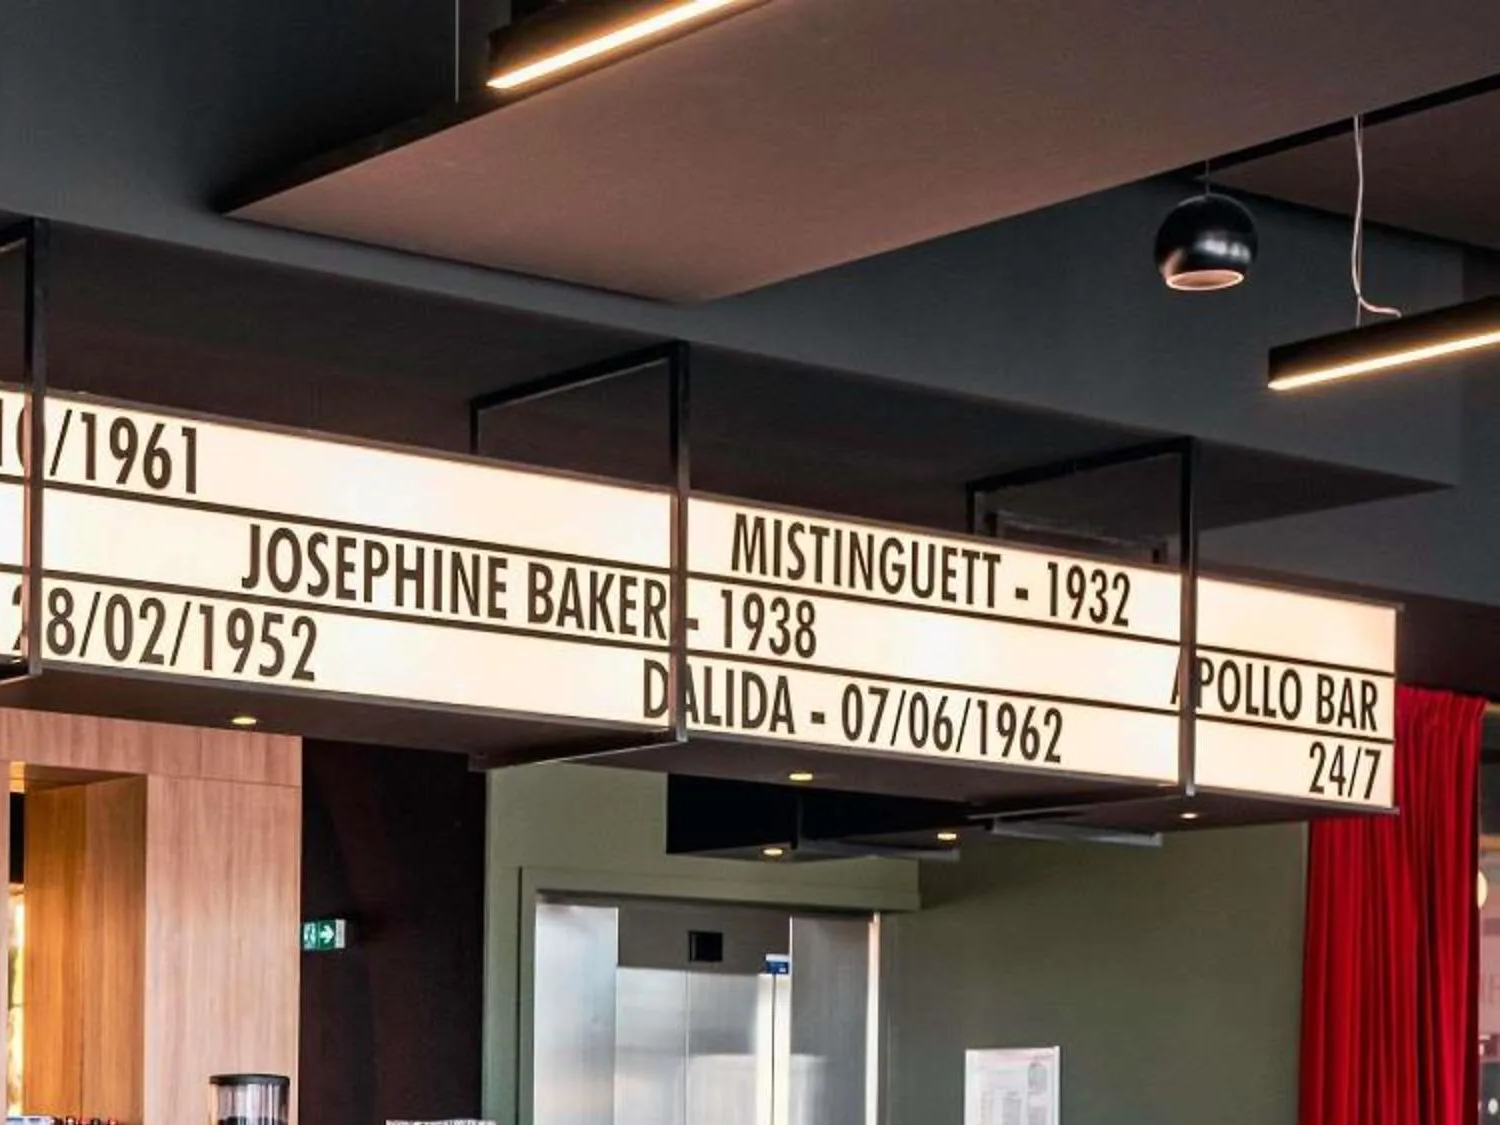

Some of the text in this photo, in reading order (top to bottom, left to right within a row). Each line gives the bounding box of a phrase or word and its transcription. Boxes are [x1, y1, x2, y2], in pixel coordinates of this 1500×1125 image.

[241, 523, 508, 620] JOSEPHINE
[527, 561, 667, 641] BAKER
[720, 588, 817, 659] 1938
[731, 512, 1002, 609] MISTINGUETT
[1047, 561, 1131, 628] 1932
[841, 683, 1063, 764] 07/06/1962
[1170, 655, 1378, 732] POLLO BAR
[1308, 741, 1382, 800] 24/7
